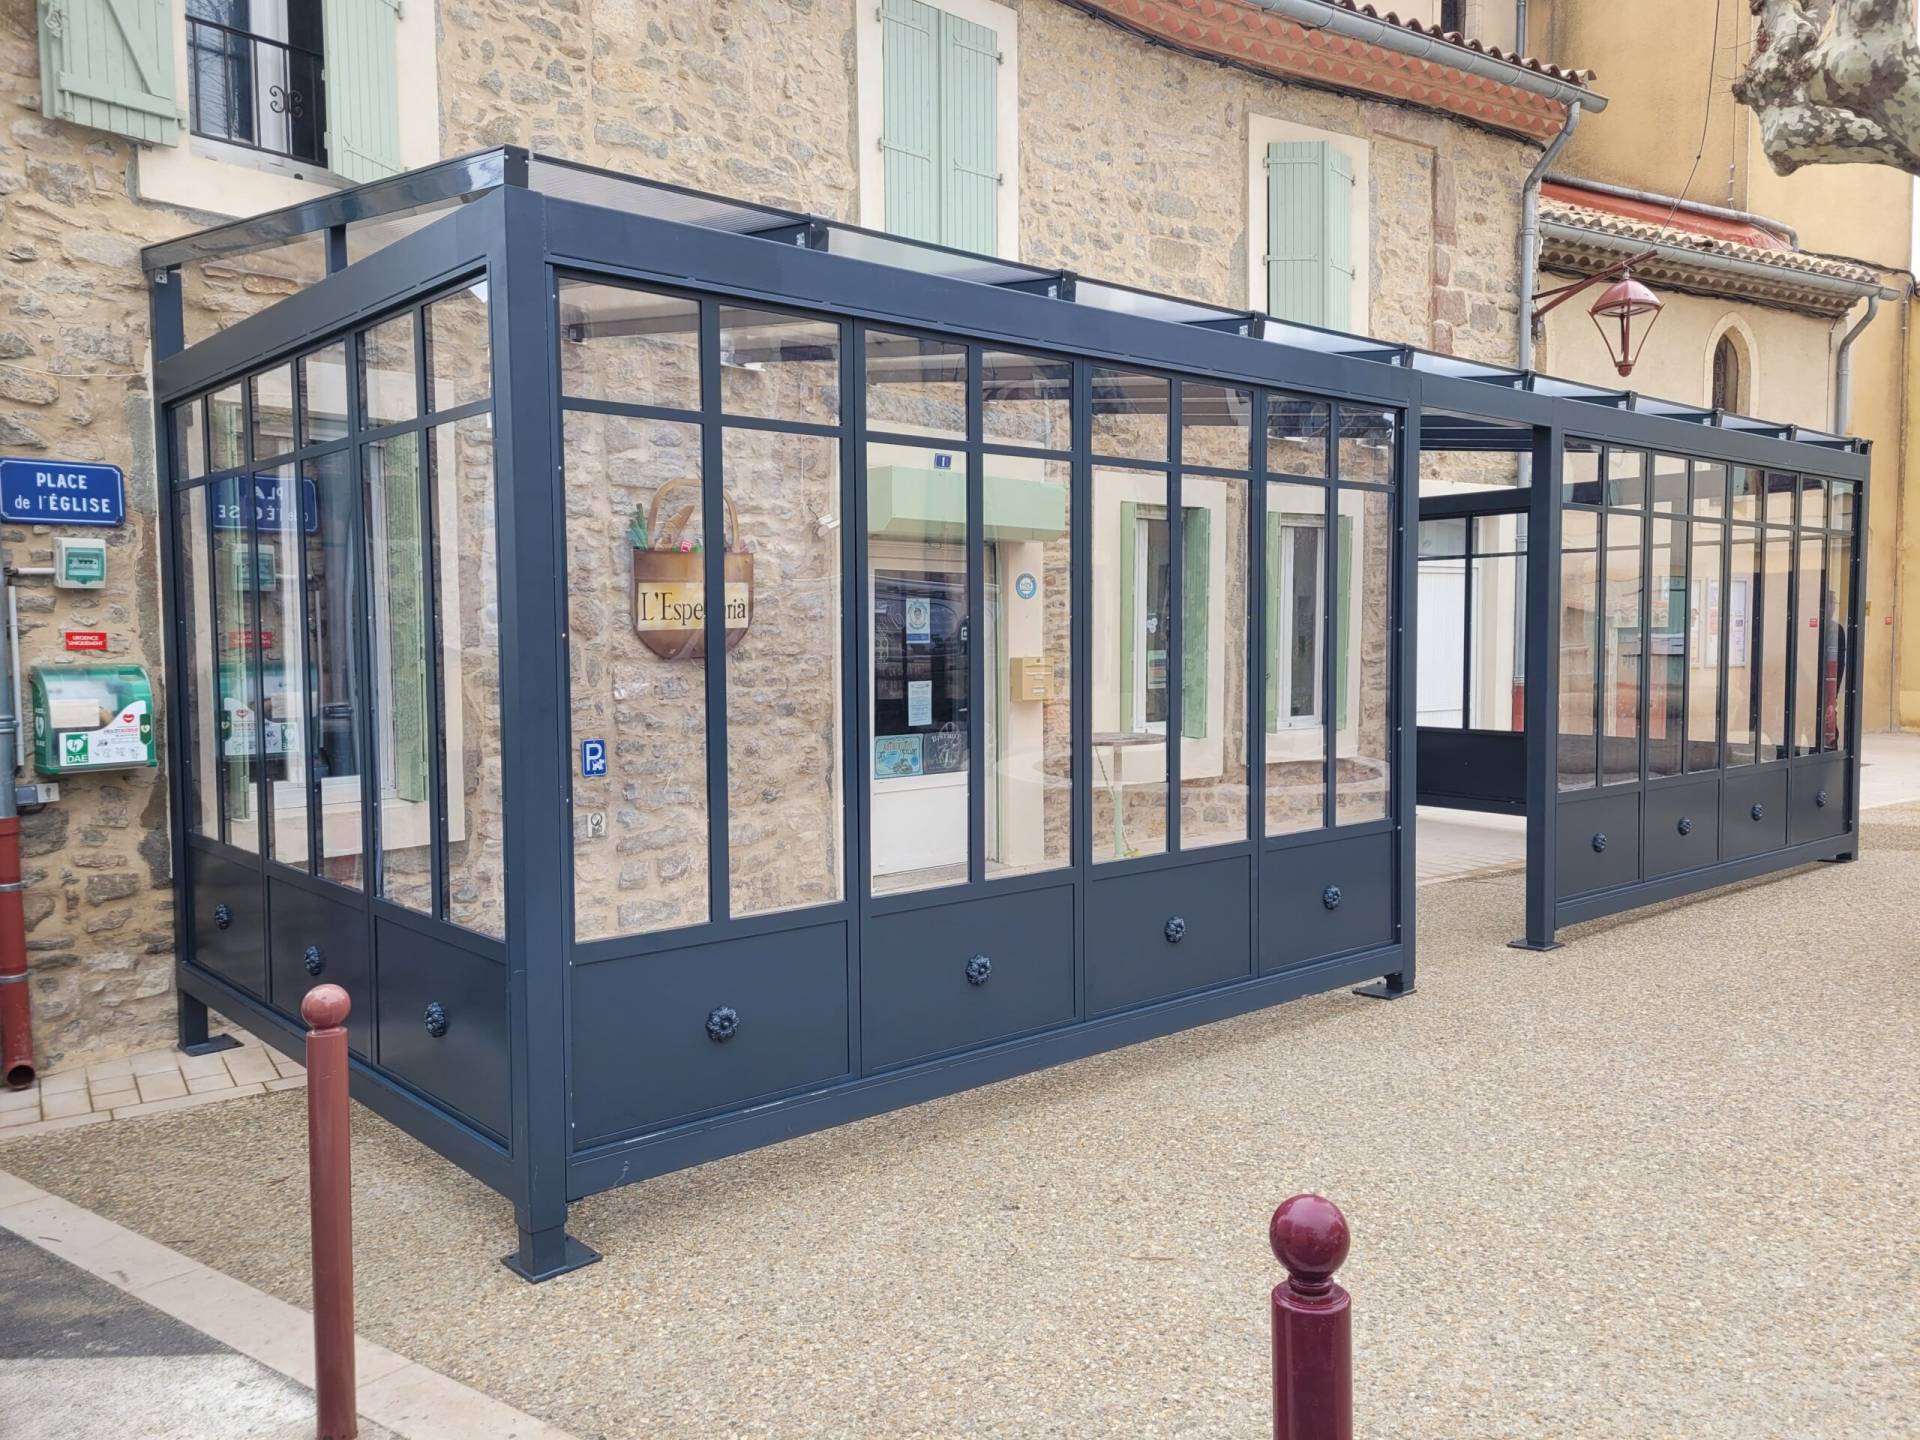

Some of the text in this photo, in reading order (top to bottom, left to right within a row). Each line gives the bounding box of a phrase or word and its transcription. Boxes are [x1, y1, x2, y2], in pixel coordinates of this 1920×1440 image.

[36, 471, 88, 490] PLACE
[14, 493, 111, 513] de l'ÉGLISE
[640, 591, 746, 626] L'Esperià
[67, 755, 89, 764] DAE
[586, 743, 603, 772] P
